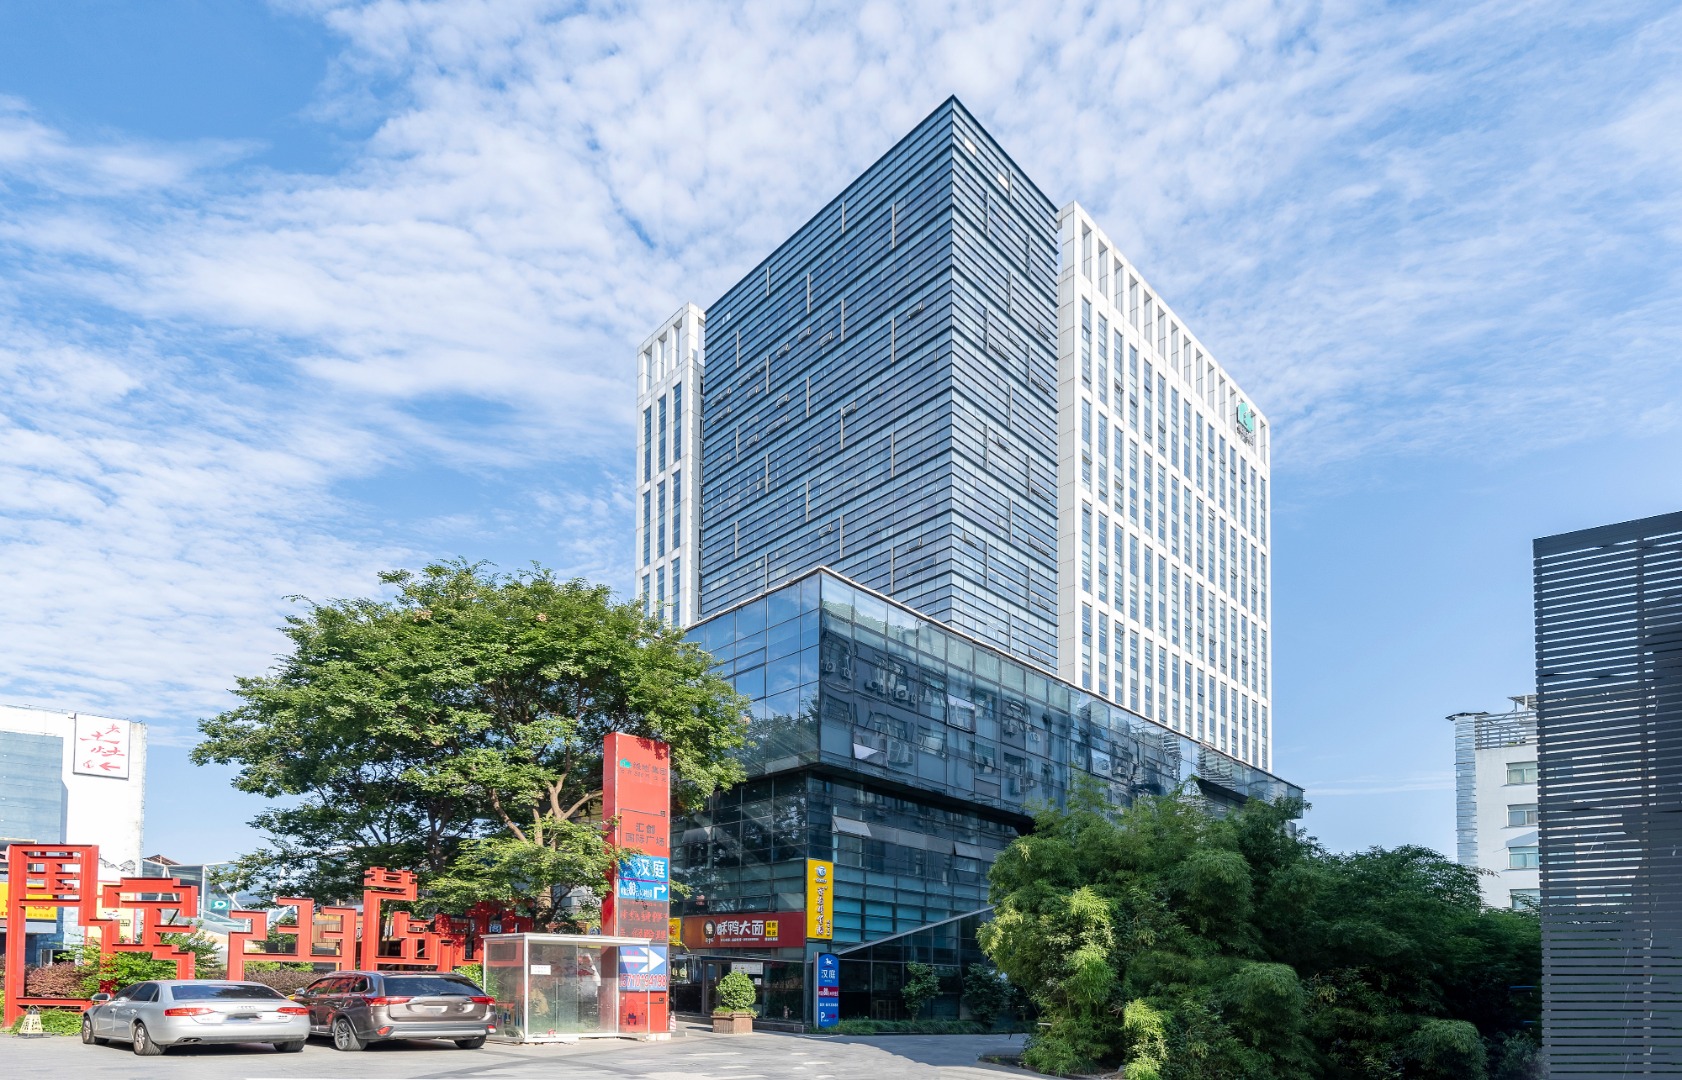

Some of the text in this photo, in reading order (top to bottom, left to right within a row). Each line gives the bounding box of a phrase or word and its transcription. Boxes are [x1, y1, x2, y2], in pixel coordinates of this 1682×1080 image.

[636, 822, 655, 834] 汇创
[625, 833, 665, 847] 国际广场
[637, 858, 665, 878] 汉庭
[821, 969, 836, 979] 汉庭
